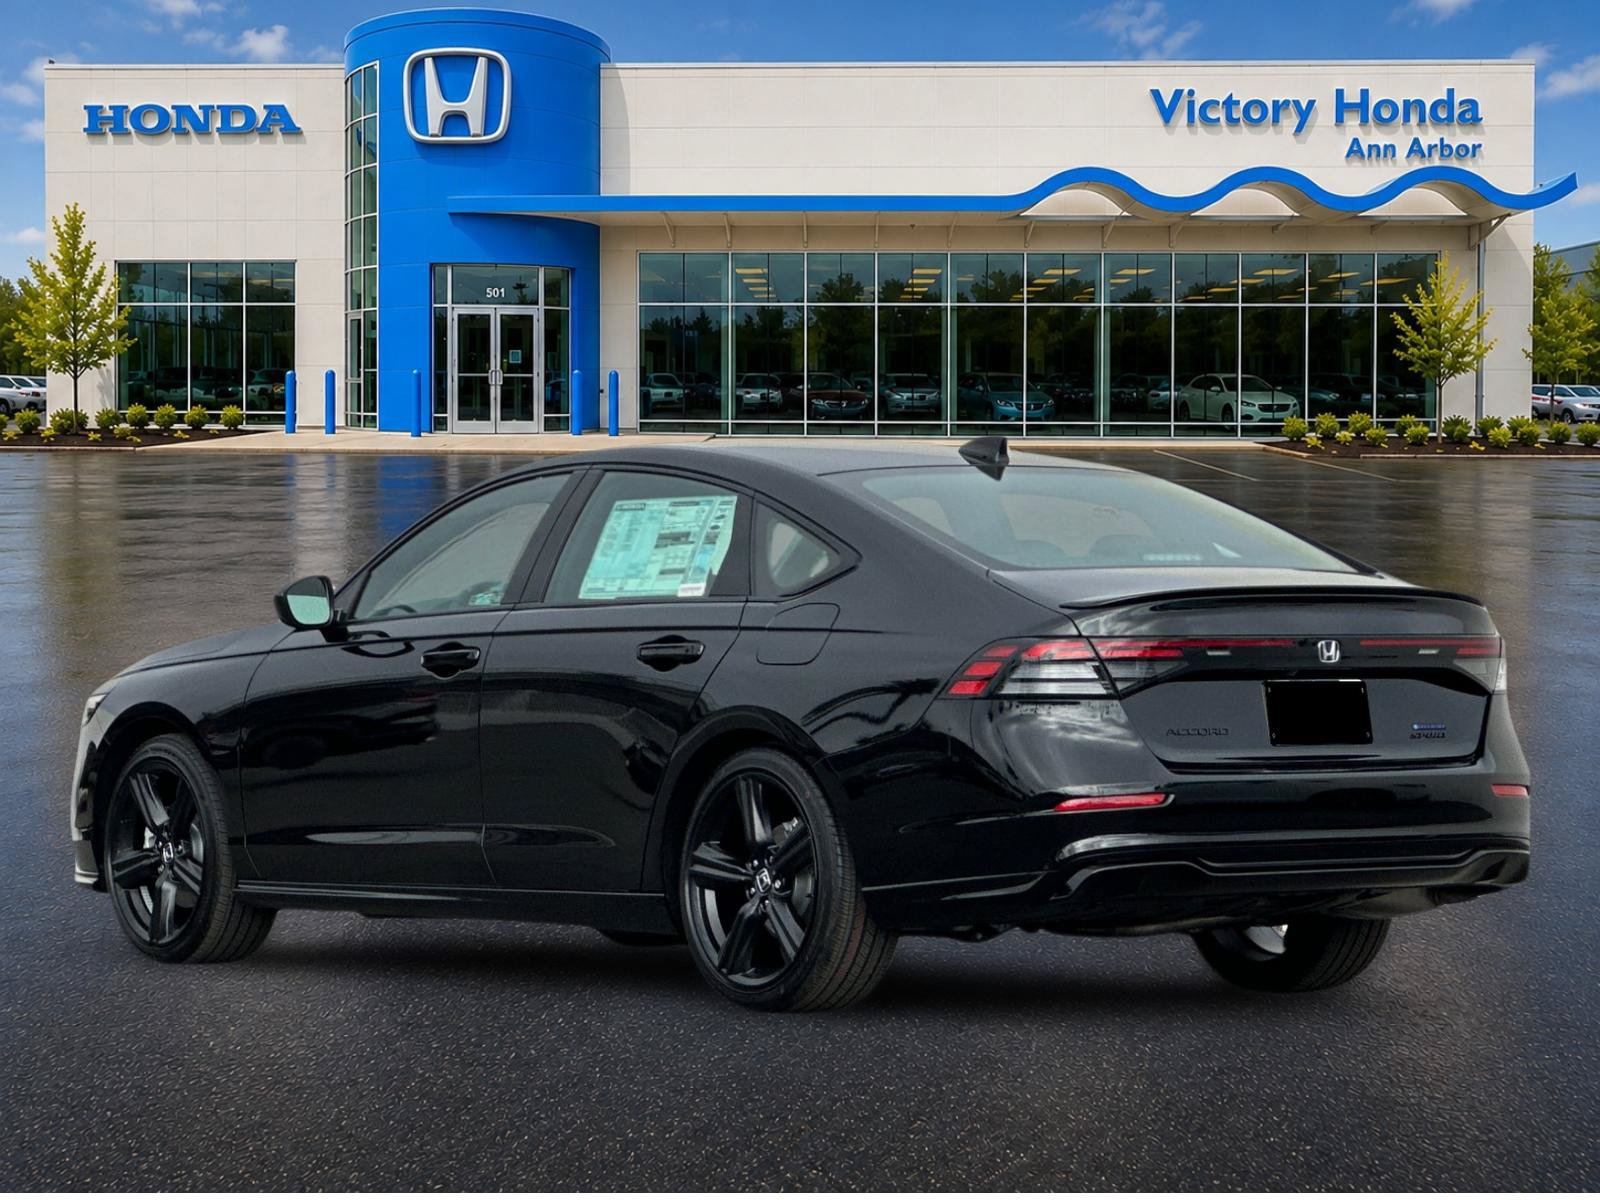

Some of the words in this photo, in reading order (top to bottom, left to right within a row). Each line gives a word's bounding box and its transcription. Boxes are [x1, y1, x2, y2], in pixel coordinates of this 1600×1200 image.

[82, 103, 303, 136] HONDA
[1150, 88, 1317, 136] Victory
[1333, 87, 1483, 127] Honda
[1345, 136, 1397, 161] Ann
[1406, 136, 1483, 161] Arbor
[485, 287, 505, 298] 501
[1165, 727, 1230, 737] ACCORD
